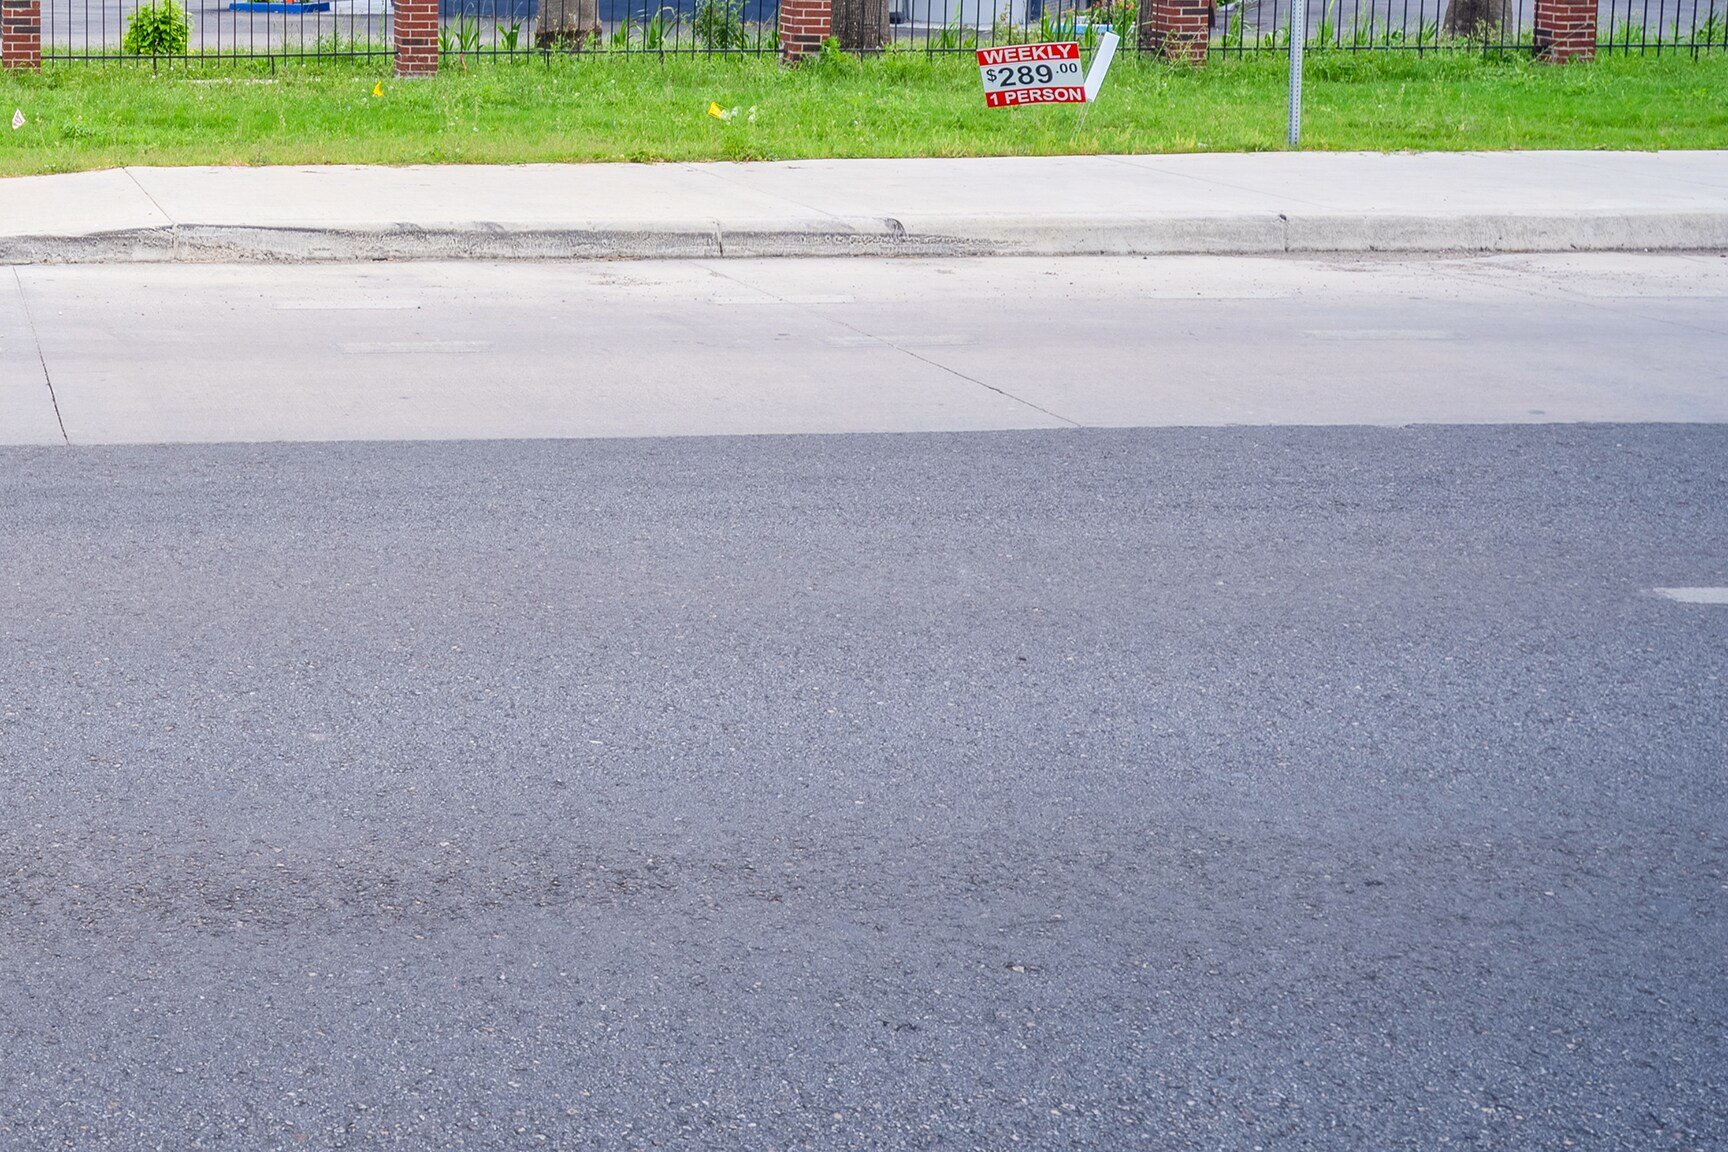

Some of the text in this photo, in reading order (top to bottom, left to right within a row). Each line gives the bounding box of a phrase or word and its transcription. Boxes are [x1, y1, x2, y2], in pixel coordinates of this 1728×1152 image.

[983, 44, 1072, 65] WEEKLY
[985, 62, 1078, 88] $289.00
[989, 88, 1083, 106] 1 PERSON
